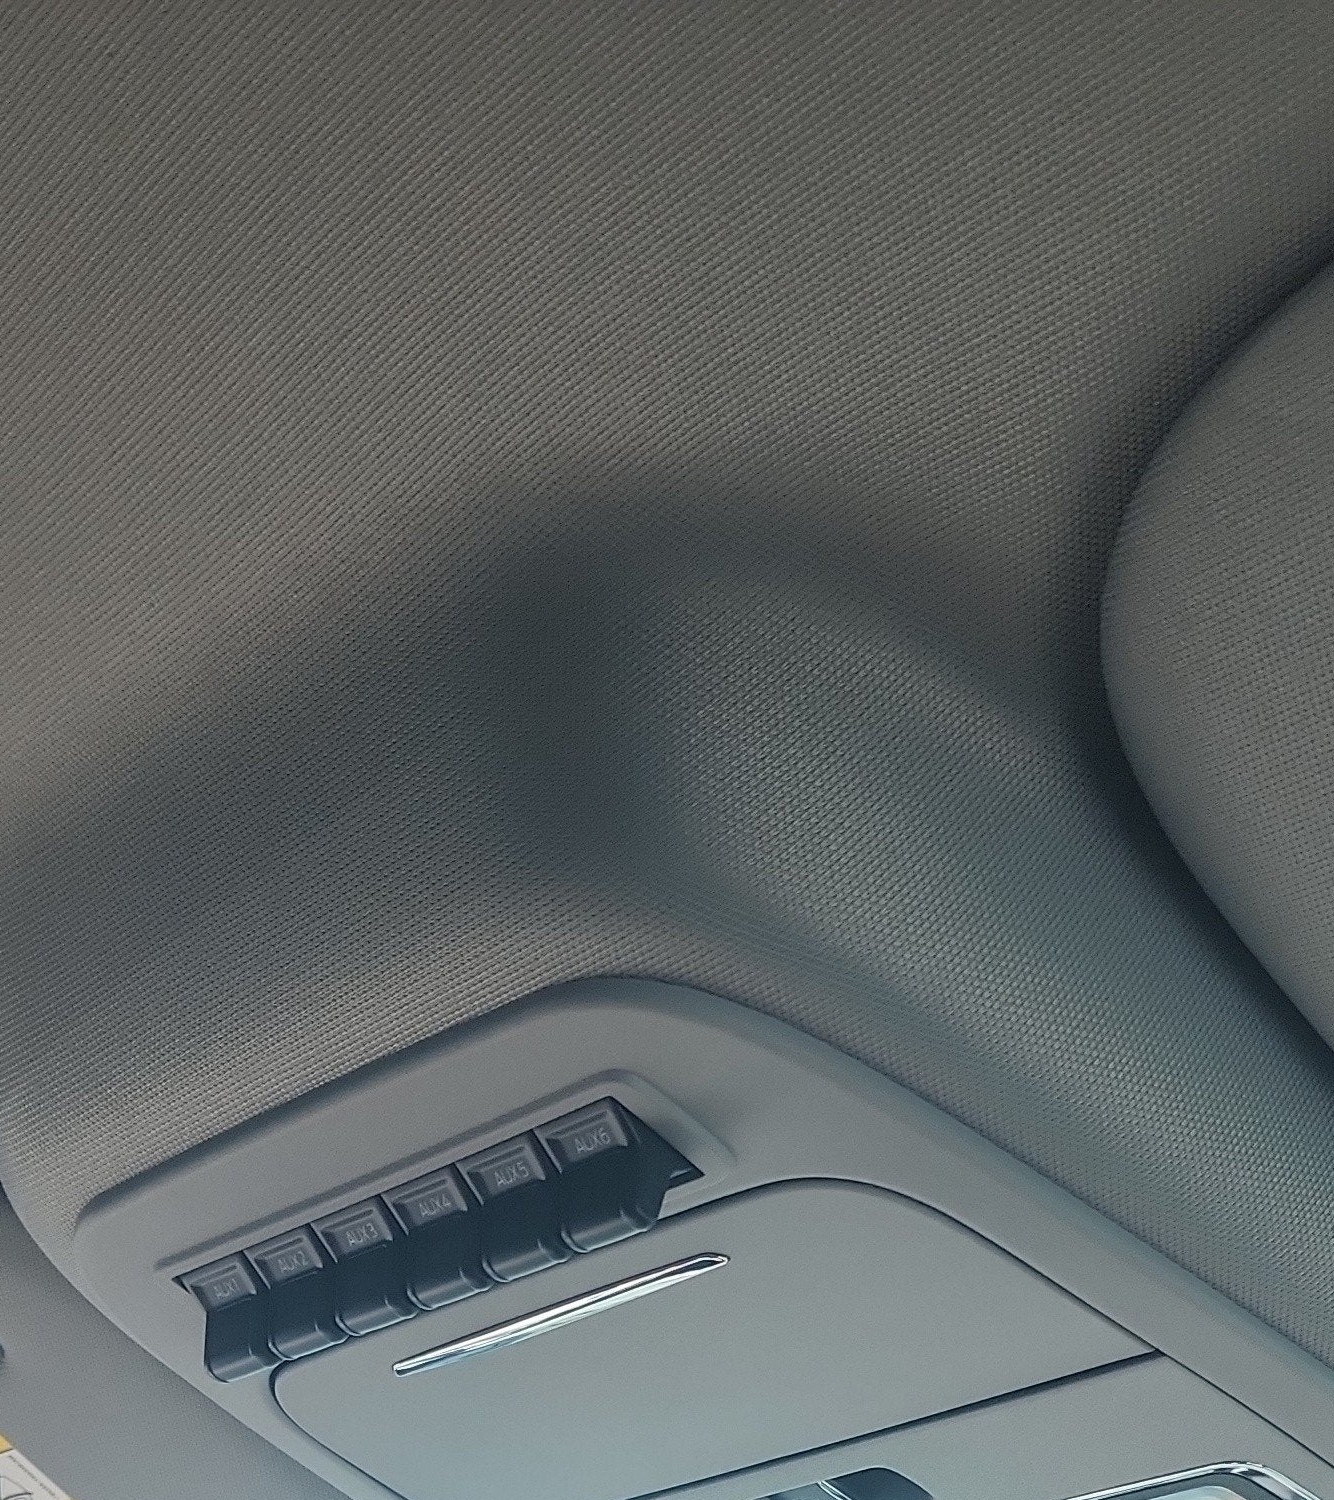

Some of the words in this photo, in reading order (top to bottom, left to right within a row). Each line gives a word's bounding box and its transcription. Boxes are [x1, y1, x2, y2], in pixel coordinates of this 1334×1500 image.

[574, 1126, 612, 1153] AUX6
[493, 1161, 531, 1187] AUX5
[418, 1193, 452, 1217] AUX4
[345, 1222, 379, 1247] AUX3
[277, 1250, 310, 1274] AUX2
[212, 1277, 239, 1299] AUX1
